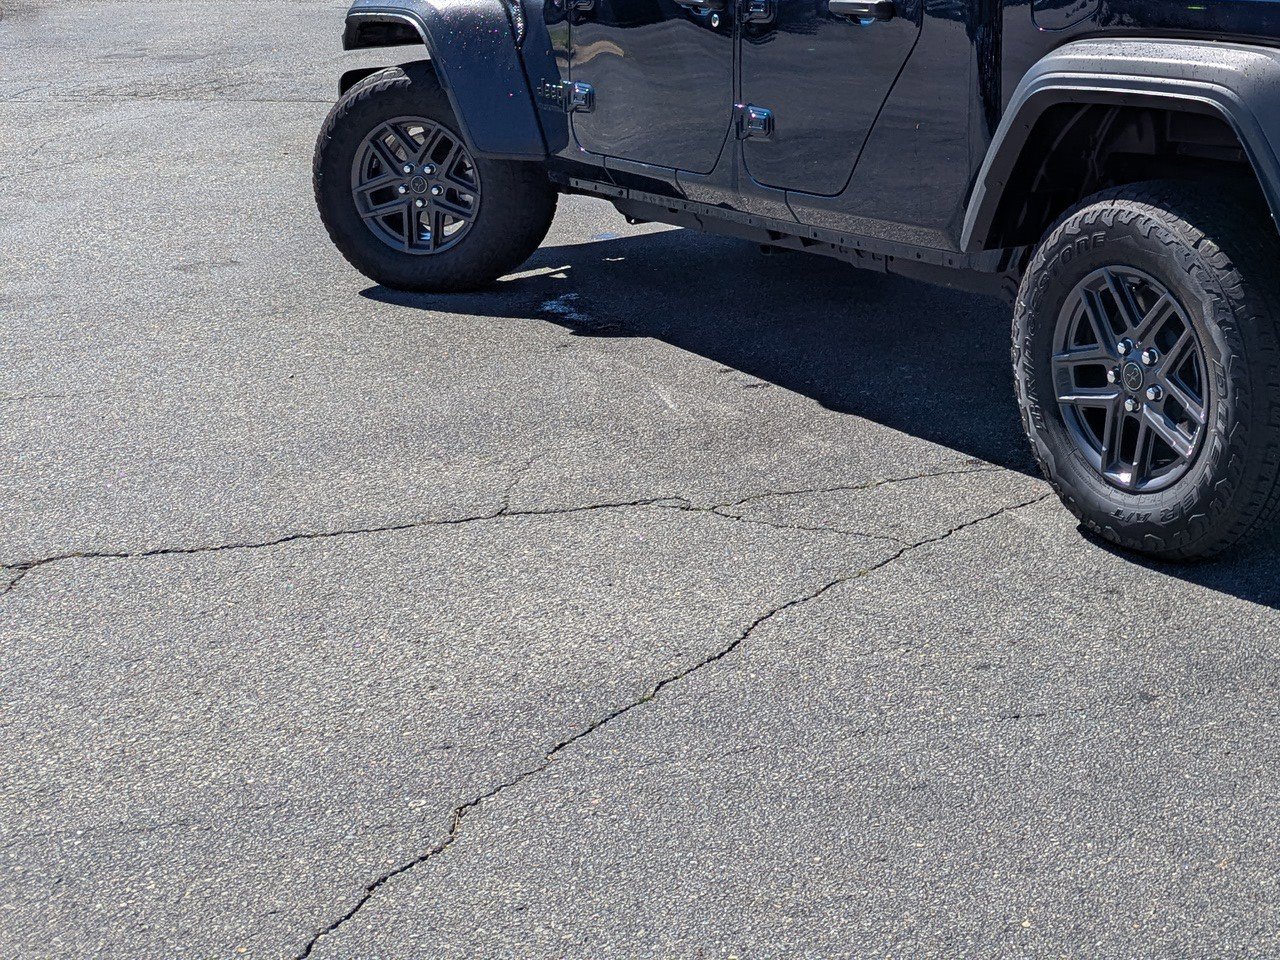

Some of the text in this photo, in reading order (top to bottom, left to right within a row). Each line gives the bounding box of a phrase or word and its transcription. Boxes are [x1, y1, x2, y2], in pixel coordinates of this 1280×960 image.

[1022, 230, 1107, 432] BRIDGESTONE
[1110, 357, 1229, 527] DUELER A/T
